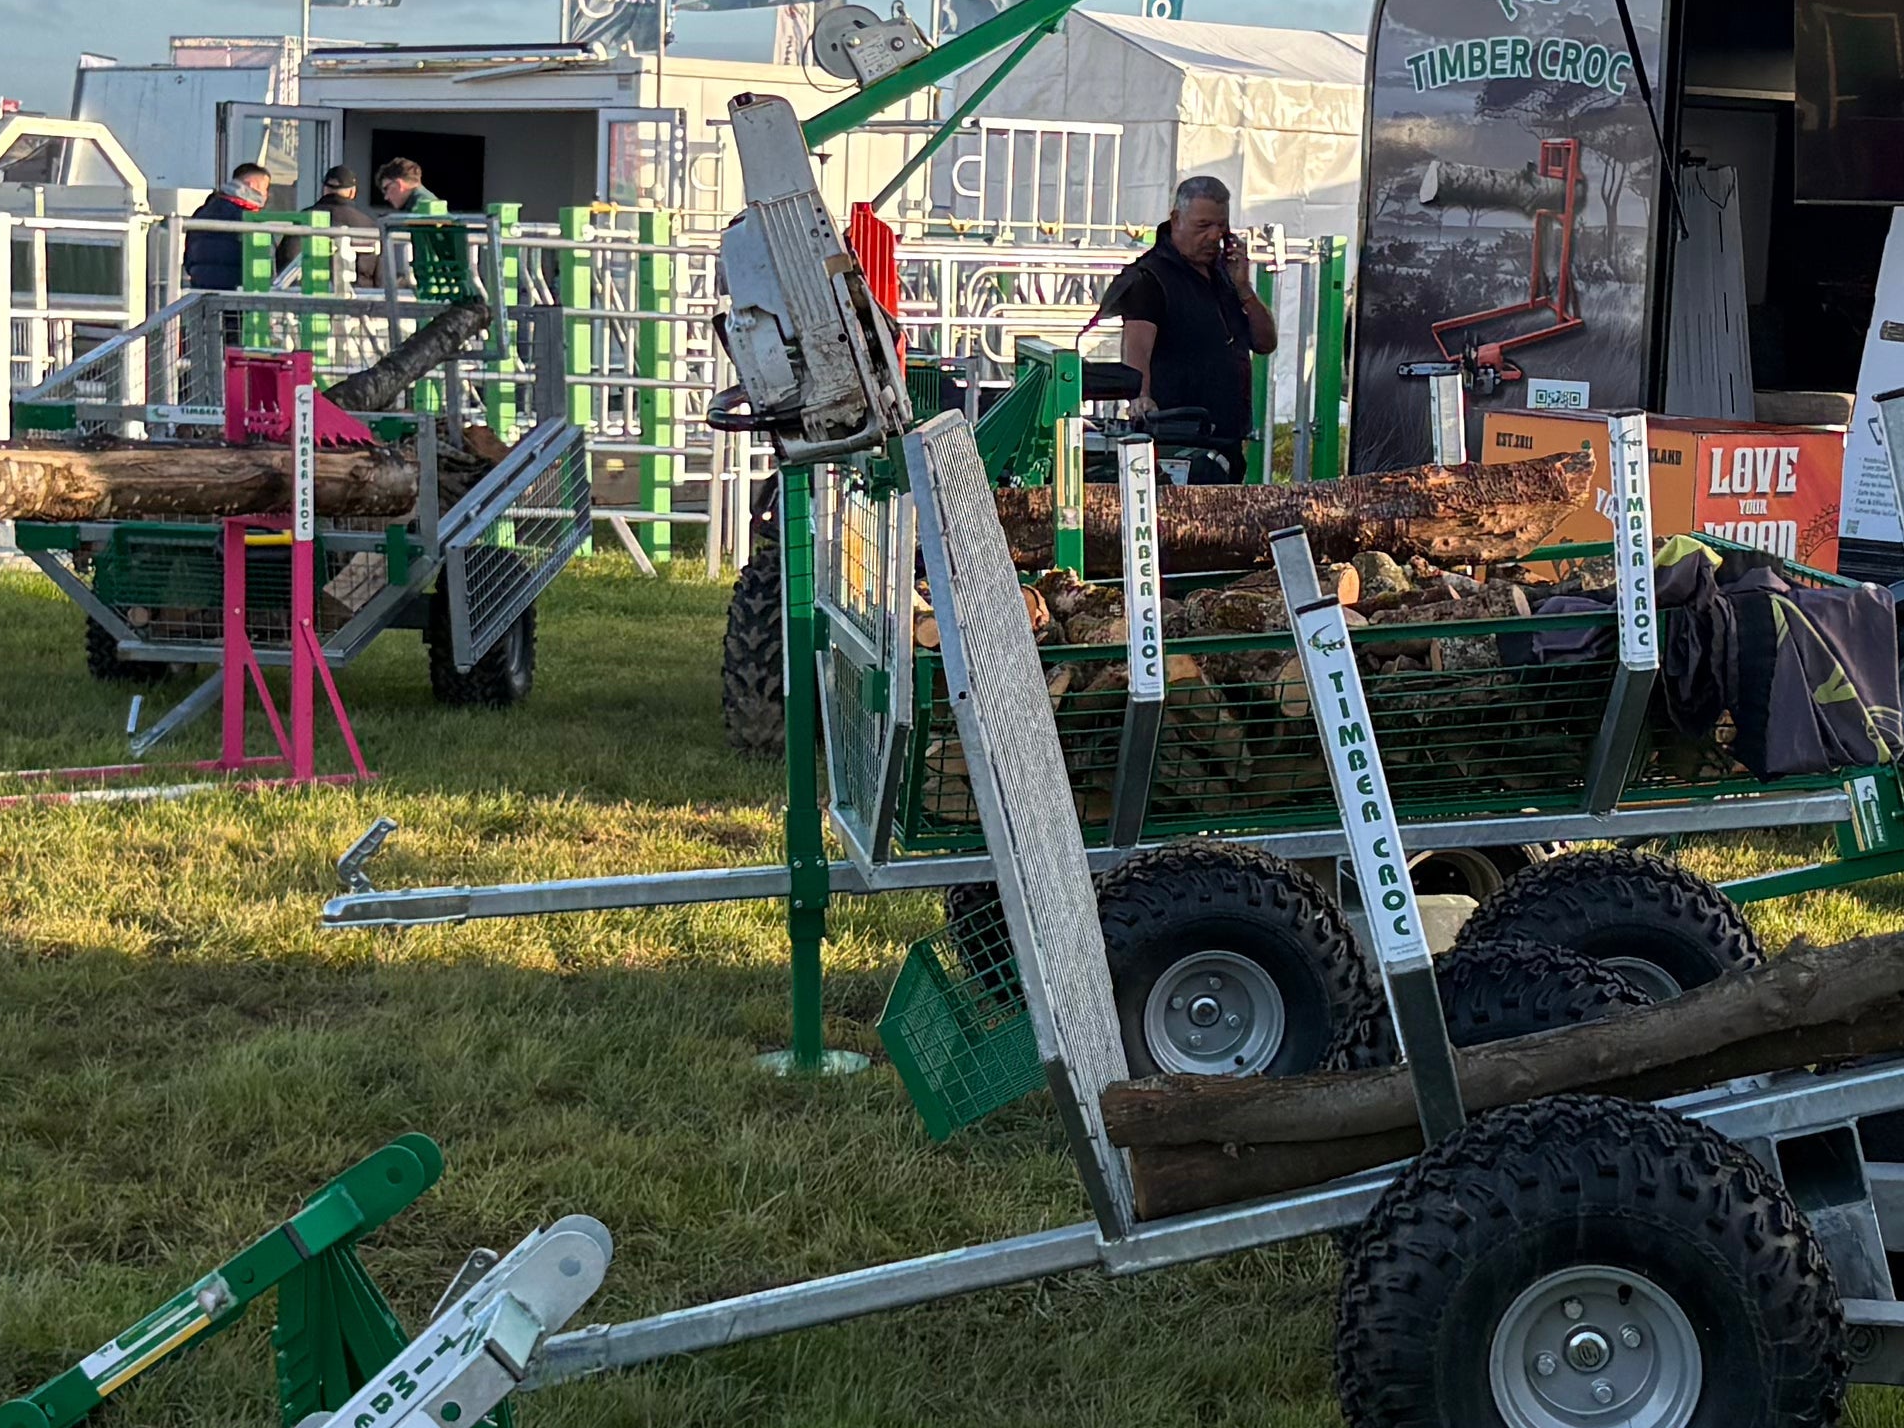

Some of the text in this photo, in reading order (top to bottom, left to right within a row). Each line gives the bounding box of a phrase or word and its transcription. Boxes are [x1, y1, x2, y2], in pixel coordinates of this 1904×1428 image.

[1405, 37, 1634, 97] TIMBER CROC
[300, 412, 311, 531] TIMBER CROC
[1710, 447, 1800, 494] LOVE
[1626, 461, 1645, 567] TIMBER
[1739, 498, 1768, 515] YOUR
[1135, 489, 1153, 597] TIMBER
[1141, 608, 1158, 677] CROC
[1634, 577, 1651, 647] CROC
[1327, 670, 1382, 824] TIMBER
[1372, 837, 1410, 937] CROC
